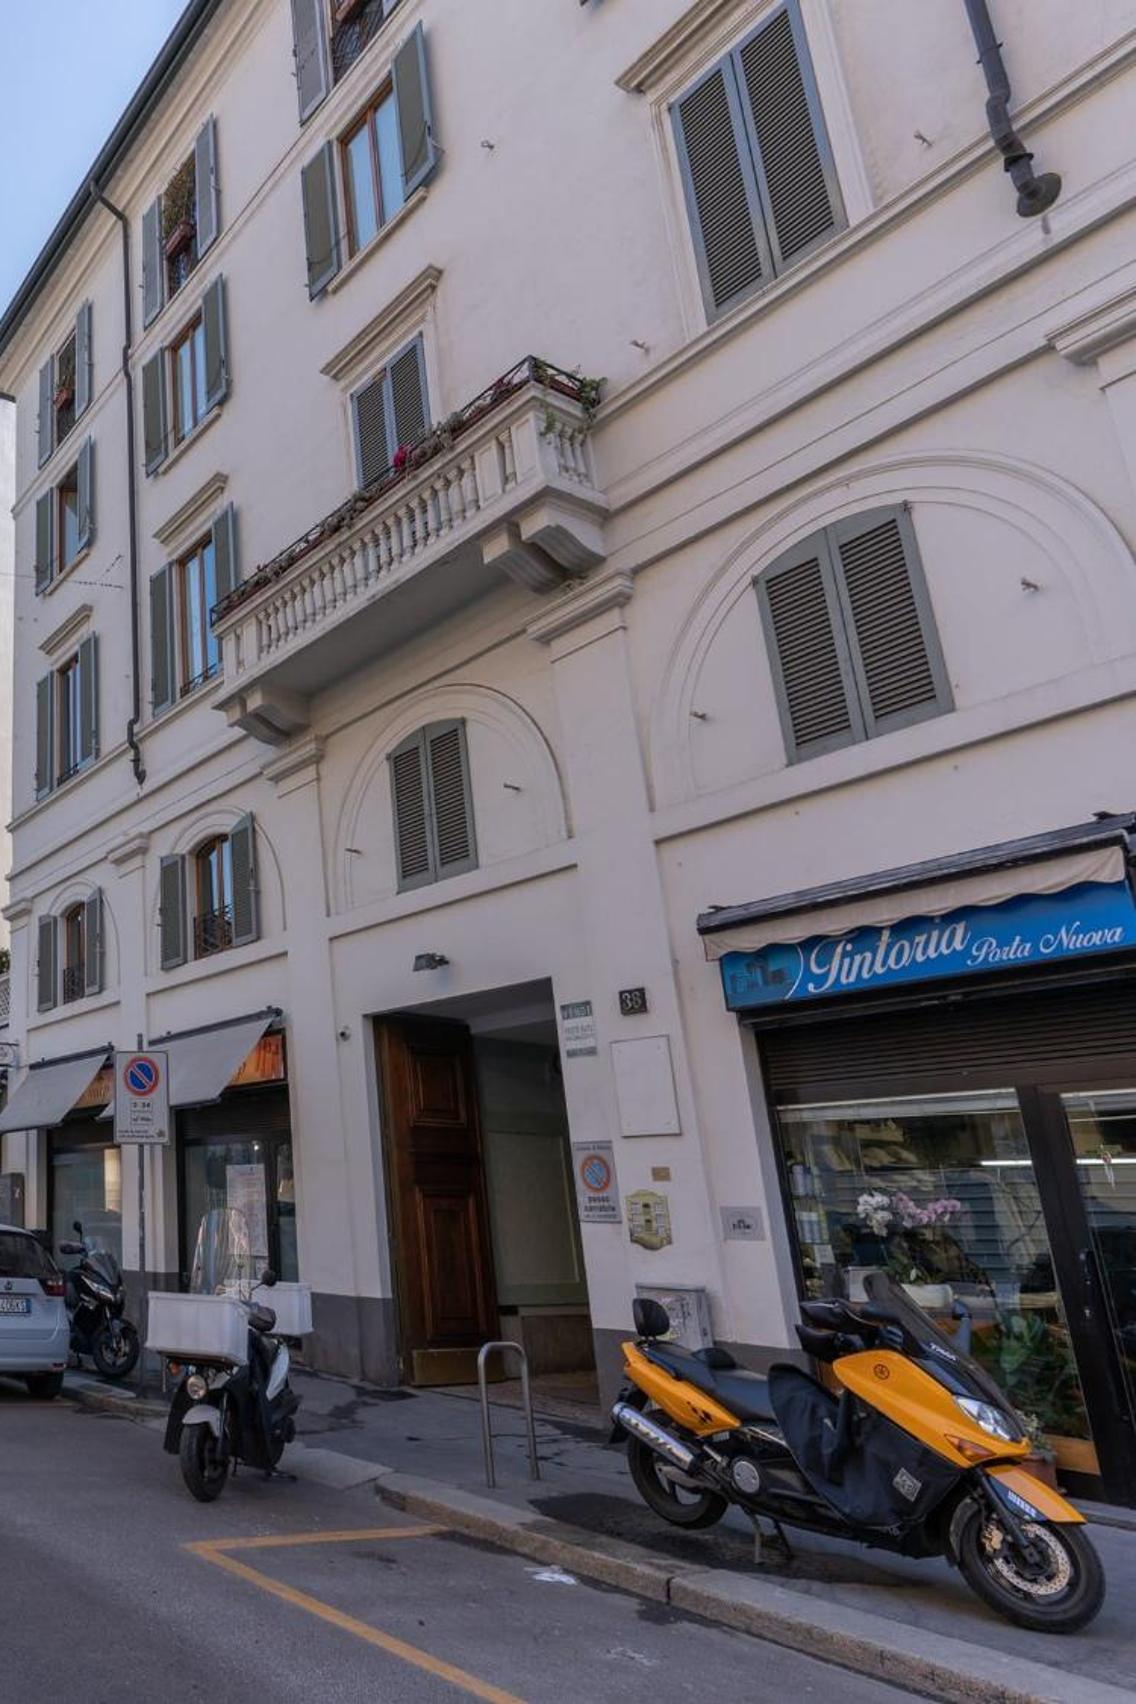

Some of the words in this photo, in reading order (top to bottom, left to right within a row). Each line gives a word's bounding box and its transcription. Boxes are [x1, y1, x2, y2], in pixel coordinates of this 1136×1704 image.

[807, 917, 971, 993] Tintoria
[967, 936, 1032, 966] Porta
[1039, 922, 1125, 955] Nuova
